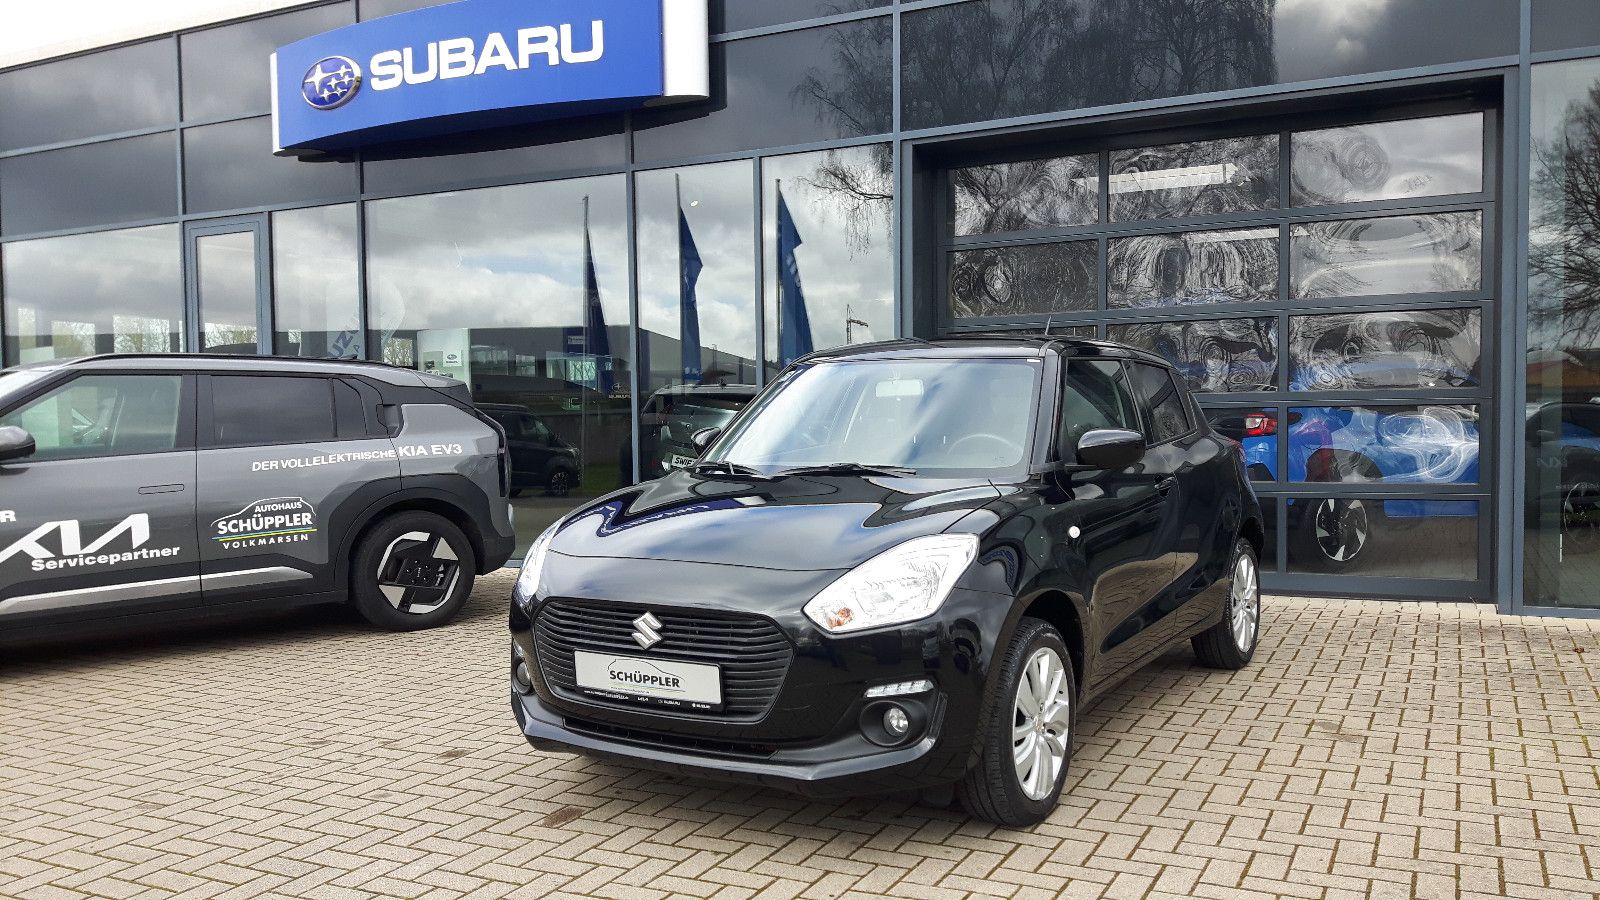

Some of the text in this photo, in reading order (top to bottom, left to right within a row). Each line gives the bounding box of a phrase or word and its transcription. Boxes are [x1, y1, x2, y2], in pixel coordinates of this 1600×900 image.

[370, 20, 604, 91] SUBARU
[251, 443, 463, 472] DER VOLLELEKTRISCHE KIA EV3
[674, 456, 695, 466] SWIF
[254, 501, 303, 514] AUTOHAUS
[217, 511, 314, 535] SCHÜPPLER
[222, 533, 309, 549] VOLKMARSEN
[31, 546, 181, 571] Servicepartner
[609, 670, 681, 688] SCHÜPPLER
